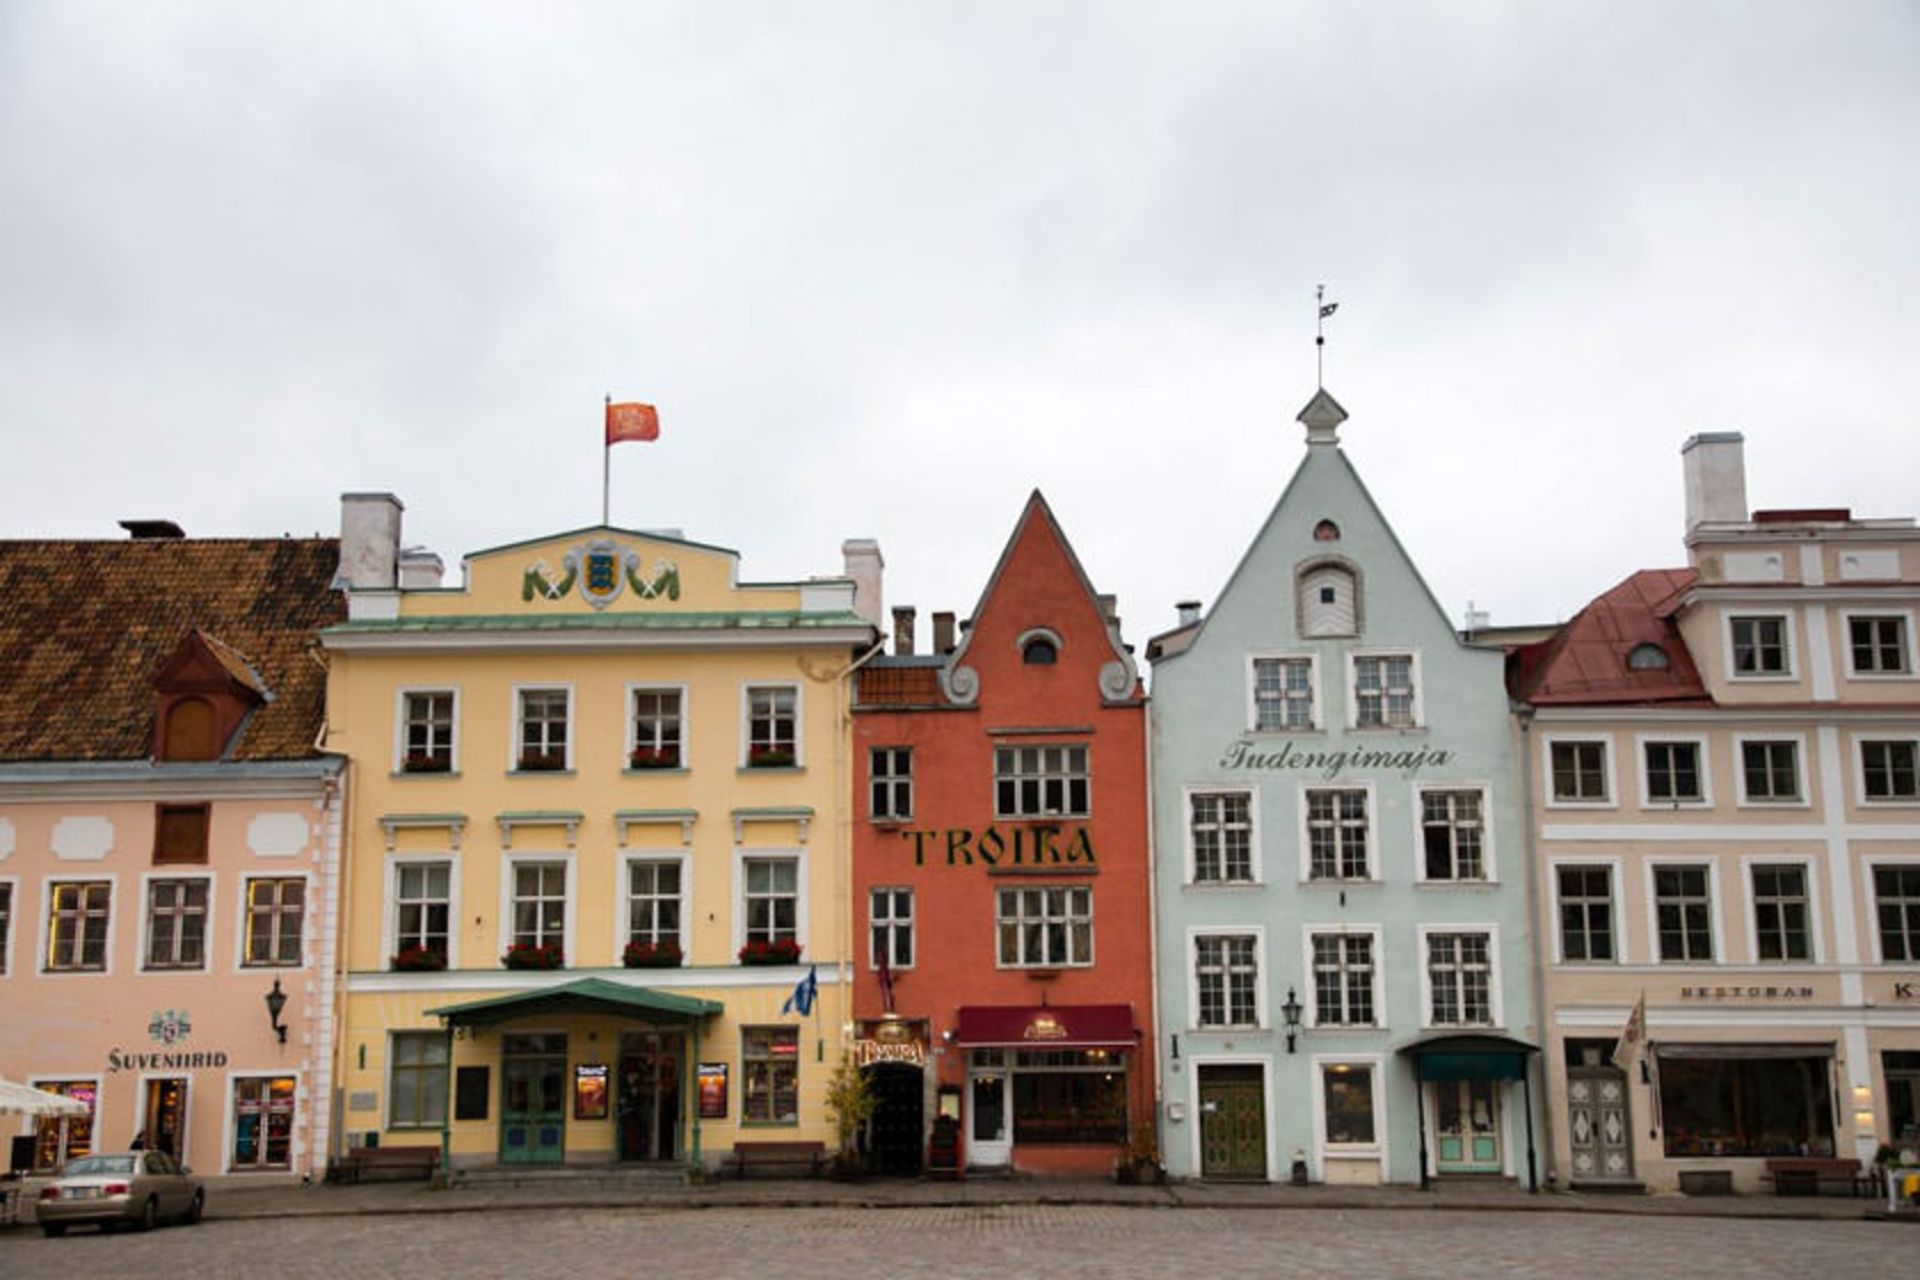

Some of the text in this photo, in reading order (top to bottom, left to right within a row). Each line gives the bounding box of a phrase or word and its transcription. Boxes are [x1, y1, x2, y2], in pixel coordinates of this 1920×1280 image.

[1219, 740, 1453, 780] Tudengimaja
[902, 826, 1096, 866] TROIKA
[109, 1047, 228, 1073] SUVENIIRID
